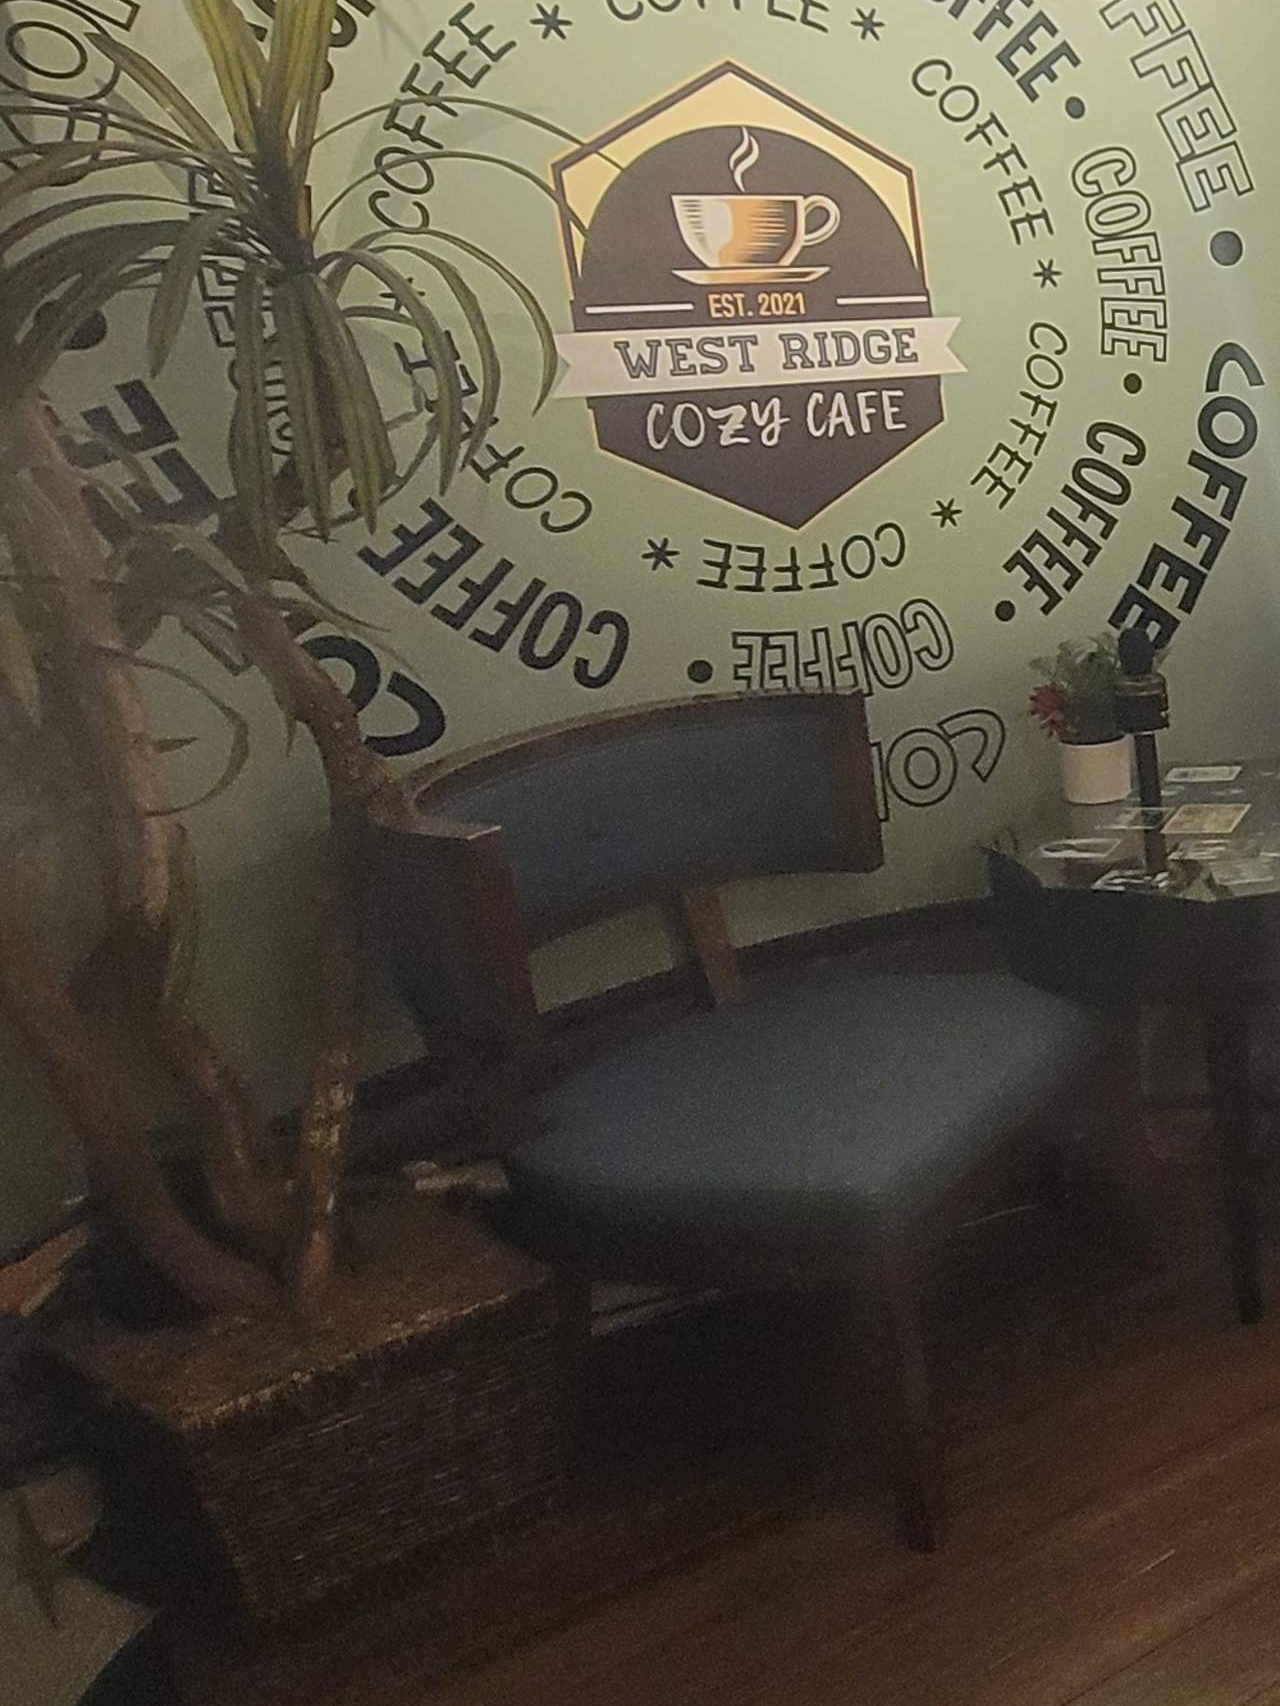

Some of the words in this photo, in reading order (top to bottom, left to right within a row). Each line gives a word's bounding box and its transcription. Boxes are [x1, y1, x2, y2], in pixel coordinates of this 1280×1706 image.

[370, 2, 517, 231] COFFEE
[910, 58, 1054, 246] COFFEE
[707, 292, 754, 319] EST.
[757, 291, 807, 317] 2021
[1070, 145, 1169, 363] COFFEE
[613, 333, 758, 379] WEST
[778, 327, 919, 371] RIDGE
[645, 396, 791, 451] COZY
[806, 389, 908, 439] CAFE
[970, 320, 1068, 510] COFFEE
[696, 521, 907, 592] COFFEE
[1002, 420, 1147, 616] COFFEE
[1107, 341, 1266, 652] COFFEE
[355, 496, 631, 690] COFFEE
[731, 597, 955, 697] COFFEE
